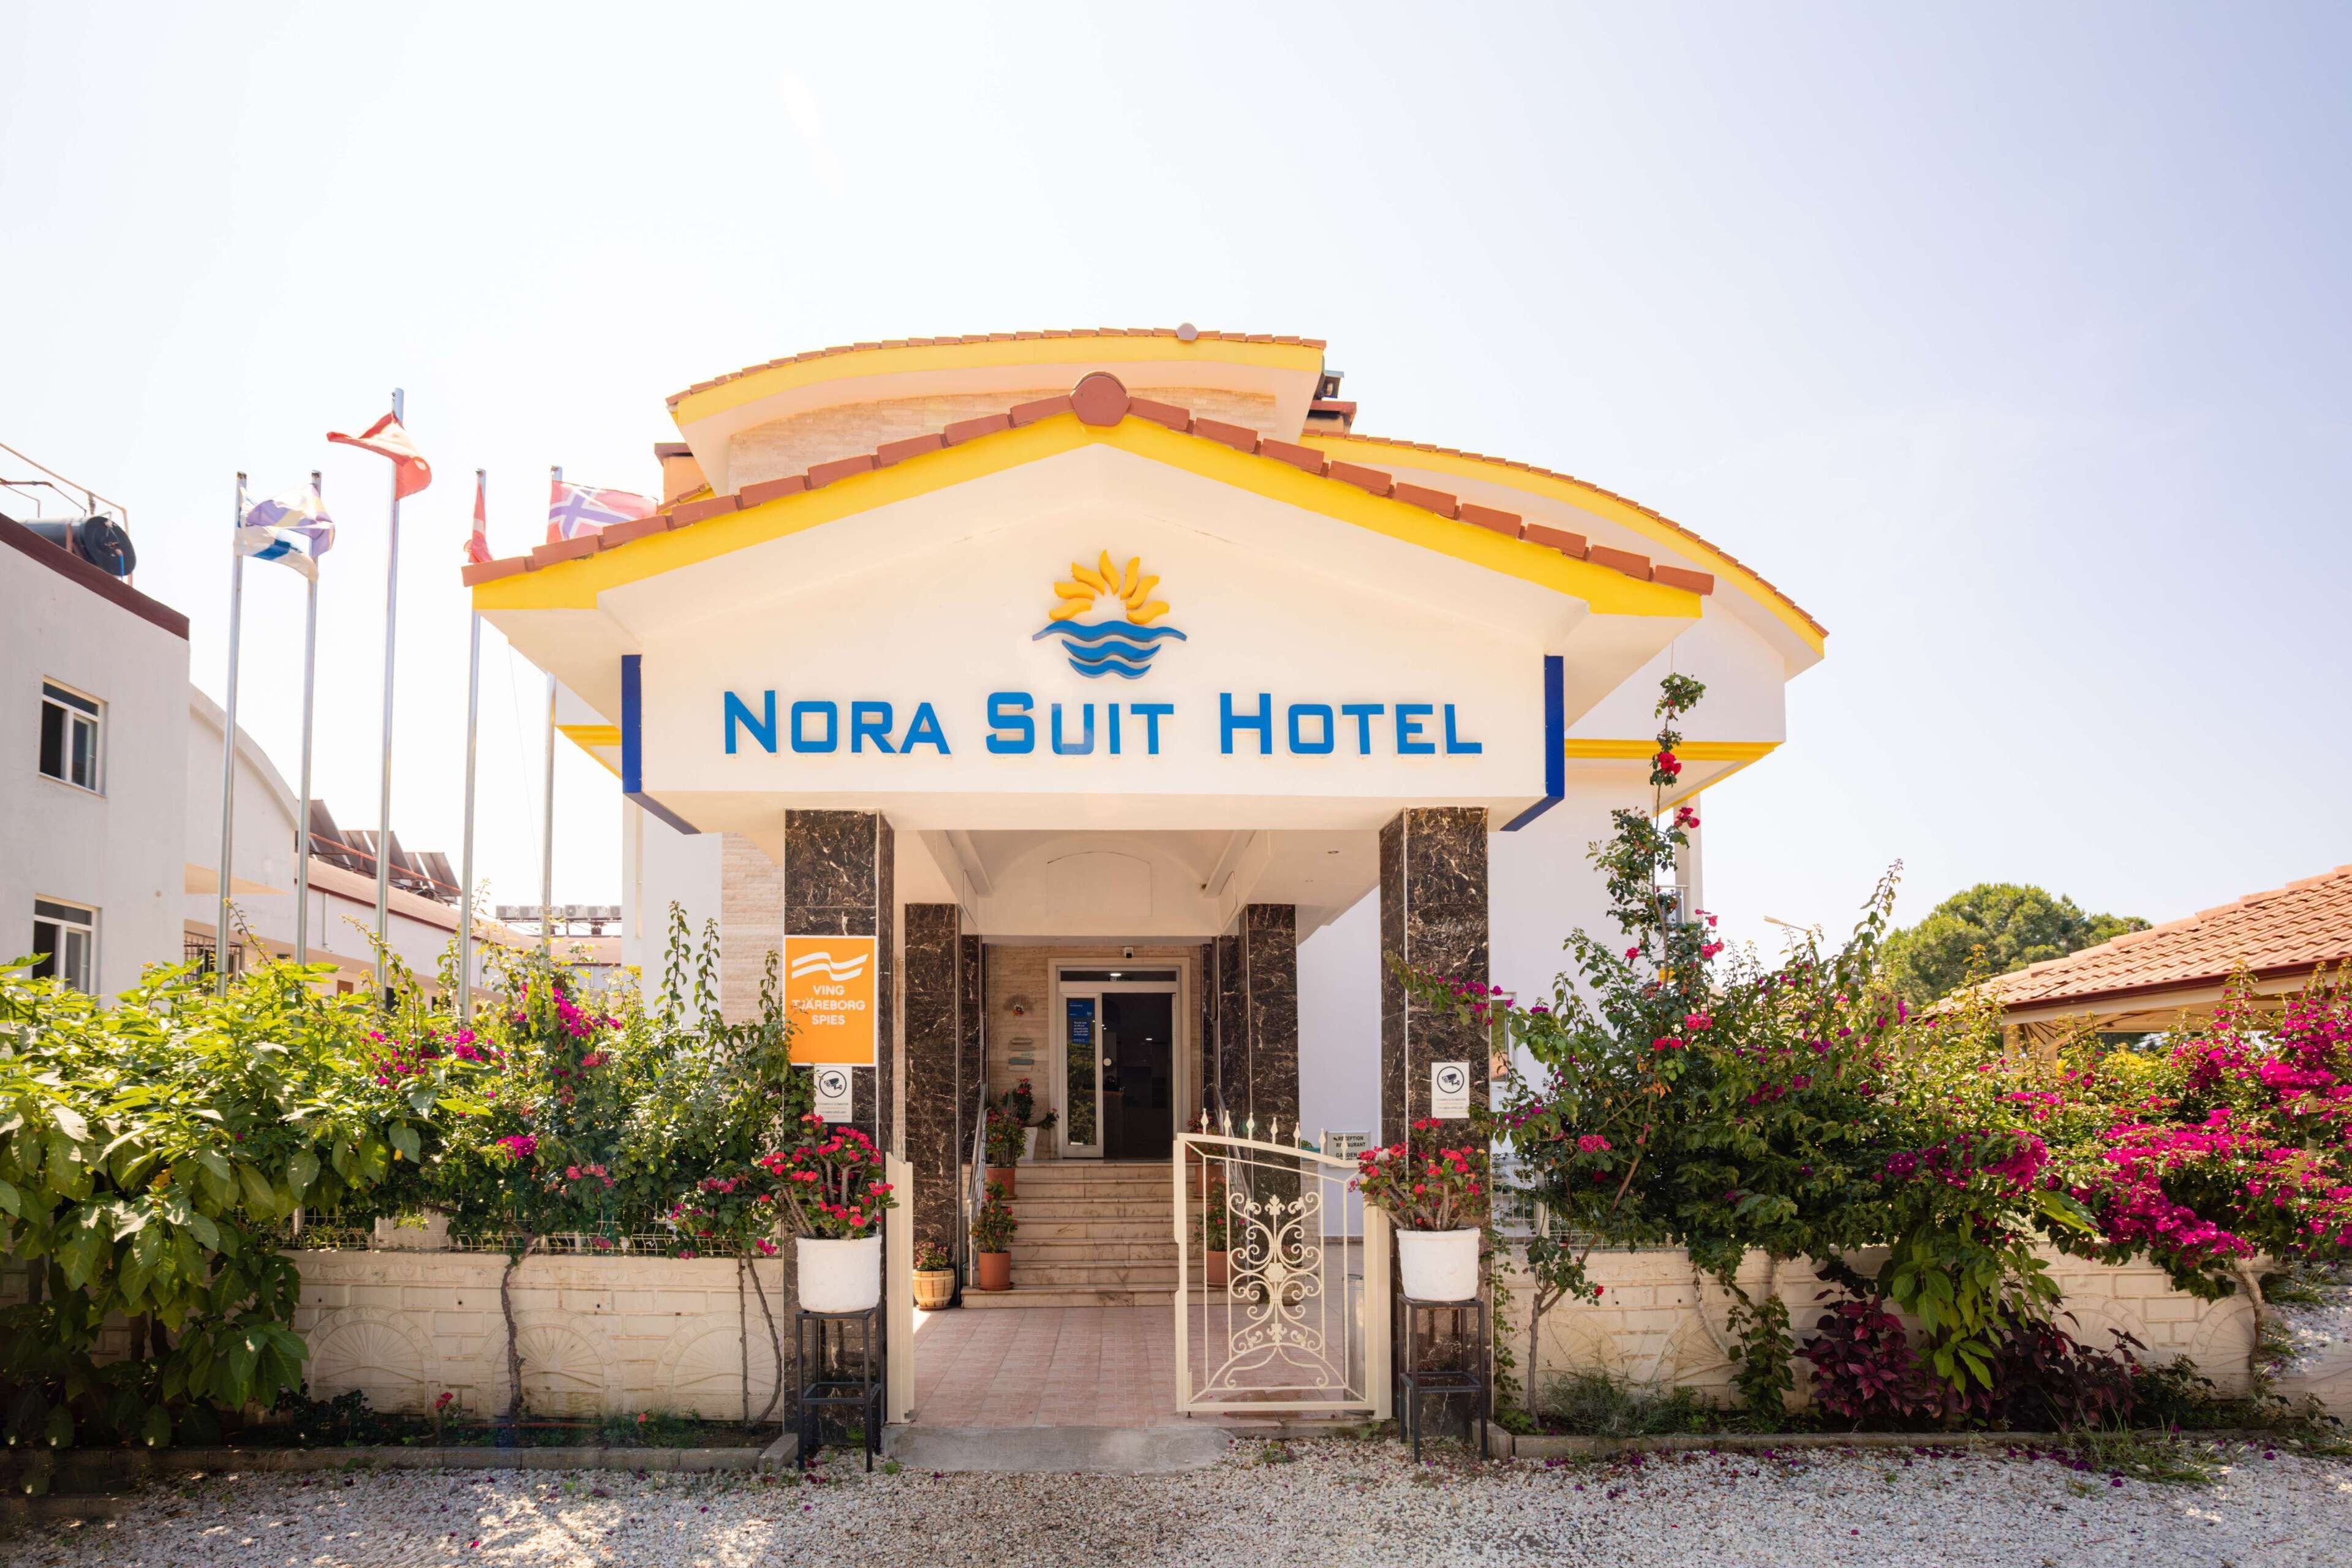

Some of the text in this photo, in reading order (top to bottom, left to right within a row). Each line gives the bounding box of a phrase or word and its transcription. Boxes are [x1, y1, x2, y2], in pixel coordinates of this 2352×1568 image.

[725, 690, 1483, 755] NORA SUIT HOTEL
[812, 984, 845, 996] VING
[791, 997, 865, 1011] TJÄREBORG
[812, 1014, 845, 1025] SPIES
